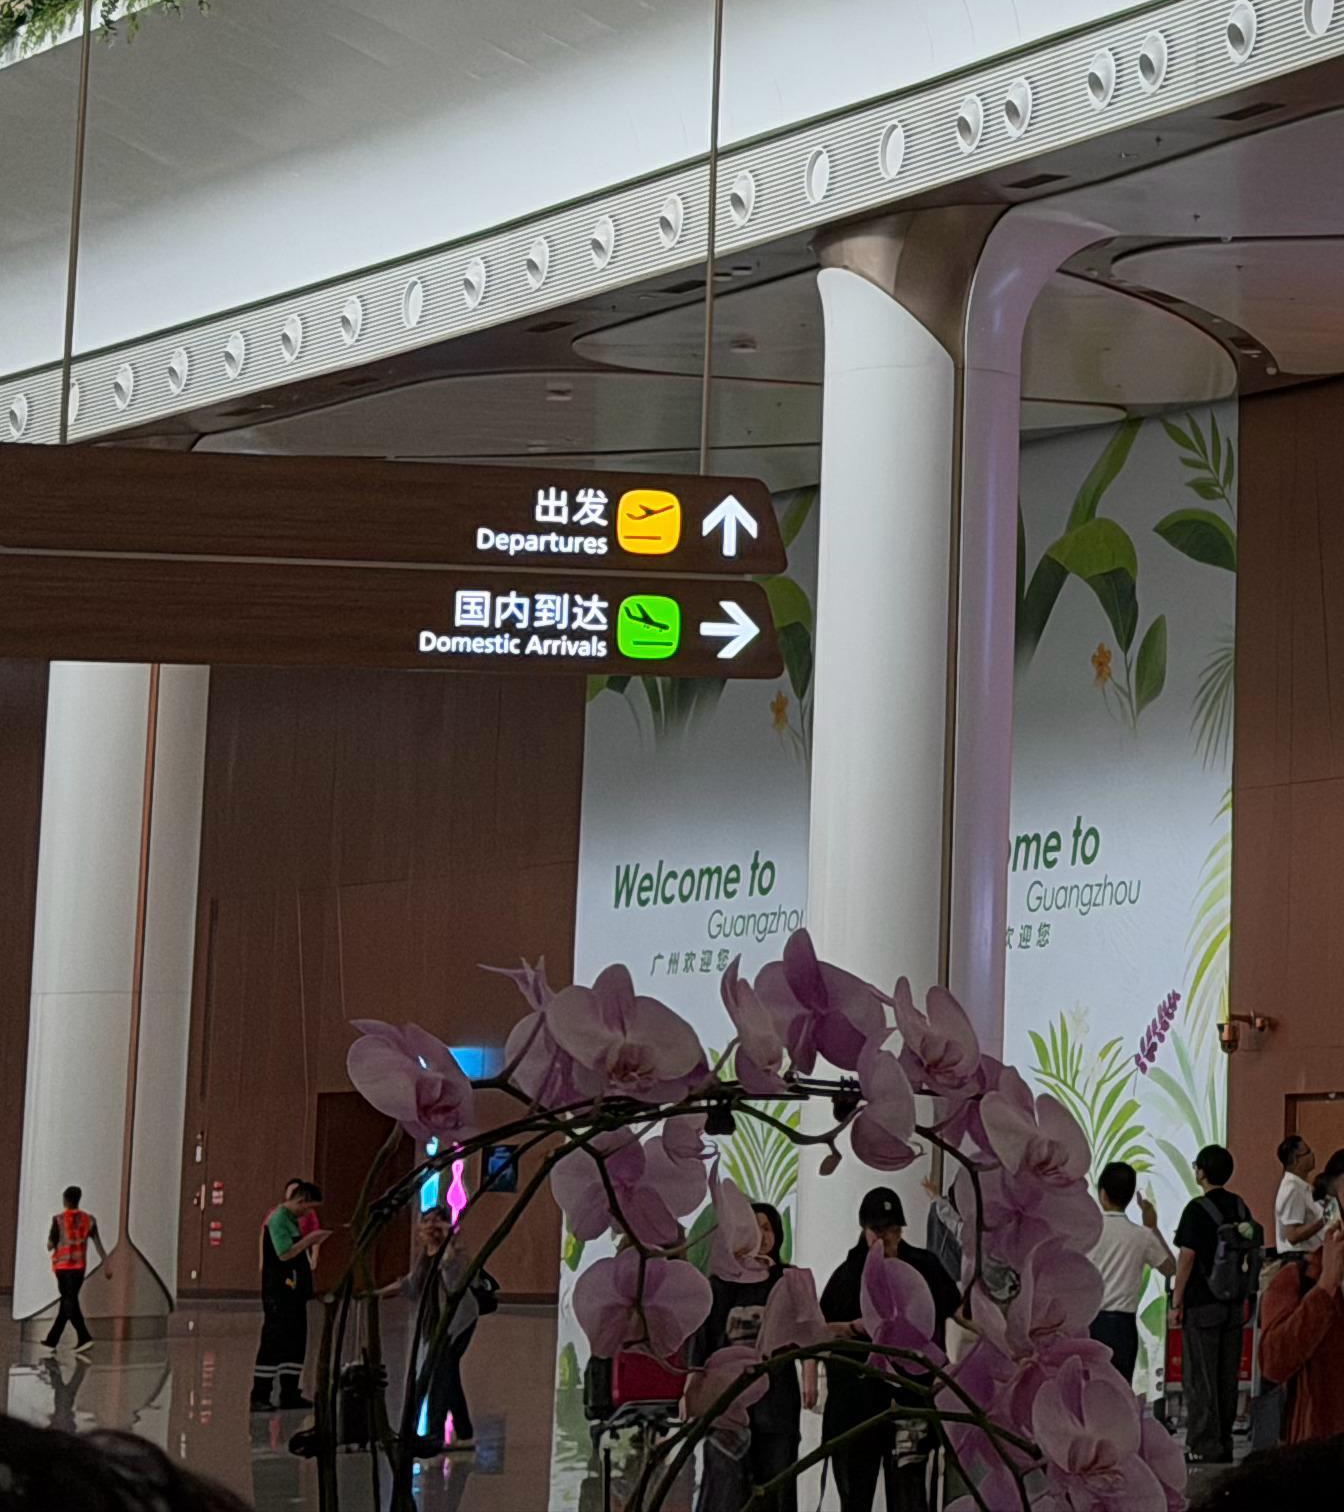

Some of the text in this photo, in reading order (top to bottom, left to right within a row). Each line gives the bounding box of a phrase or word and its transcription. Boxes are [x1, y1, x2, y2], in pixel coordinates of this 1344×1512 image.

[535, 487, 609, 527] 出发
[476, 527, 609, 556] Departures
[454, 590, 609, 631] 国内到达
[419, 631, 607, 657] Domestic Arrivals
[1008, 816, 1100, 872] me to
[614, 850, 776, 909] Welcome to
[1026, 873, 1141, 916] Guangzhou
[650, 948, 730, 976] 广州欢迎您
